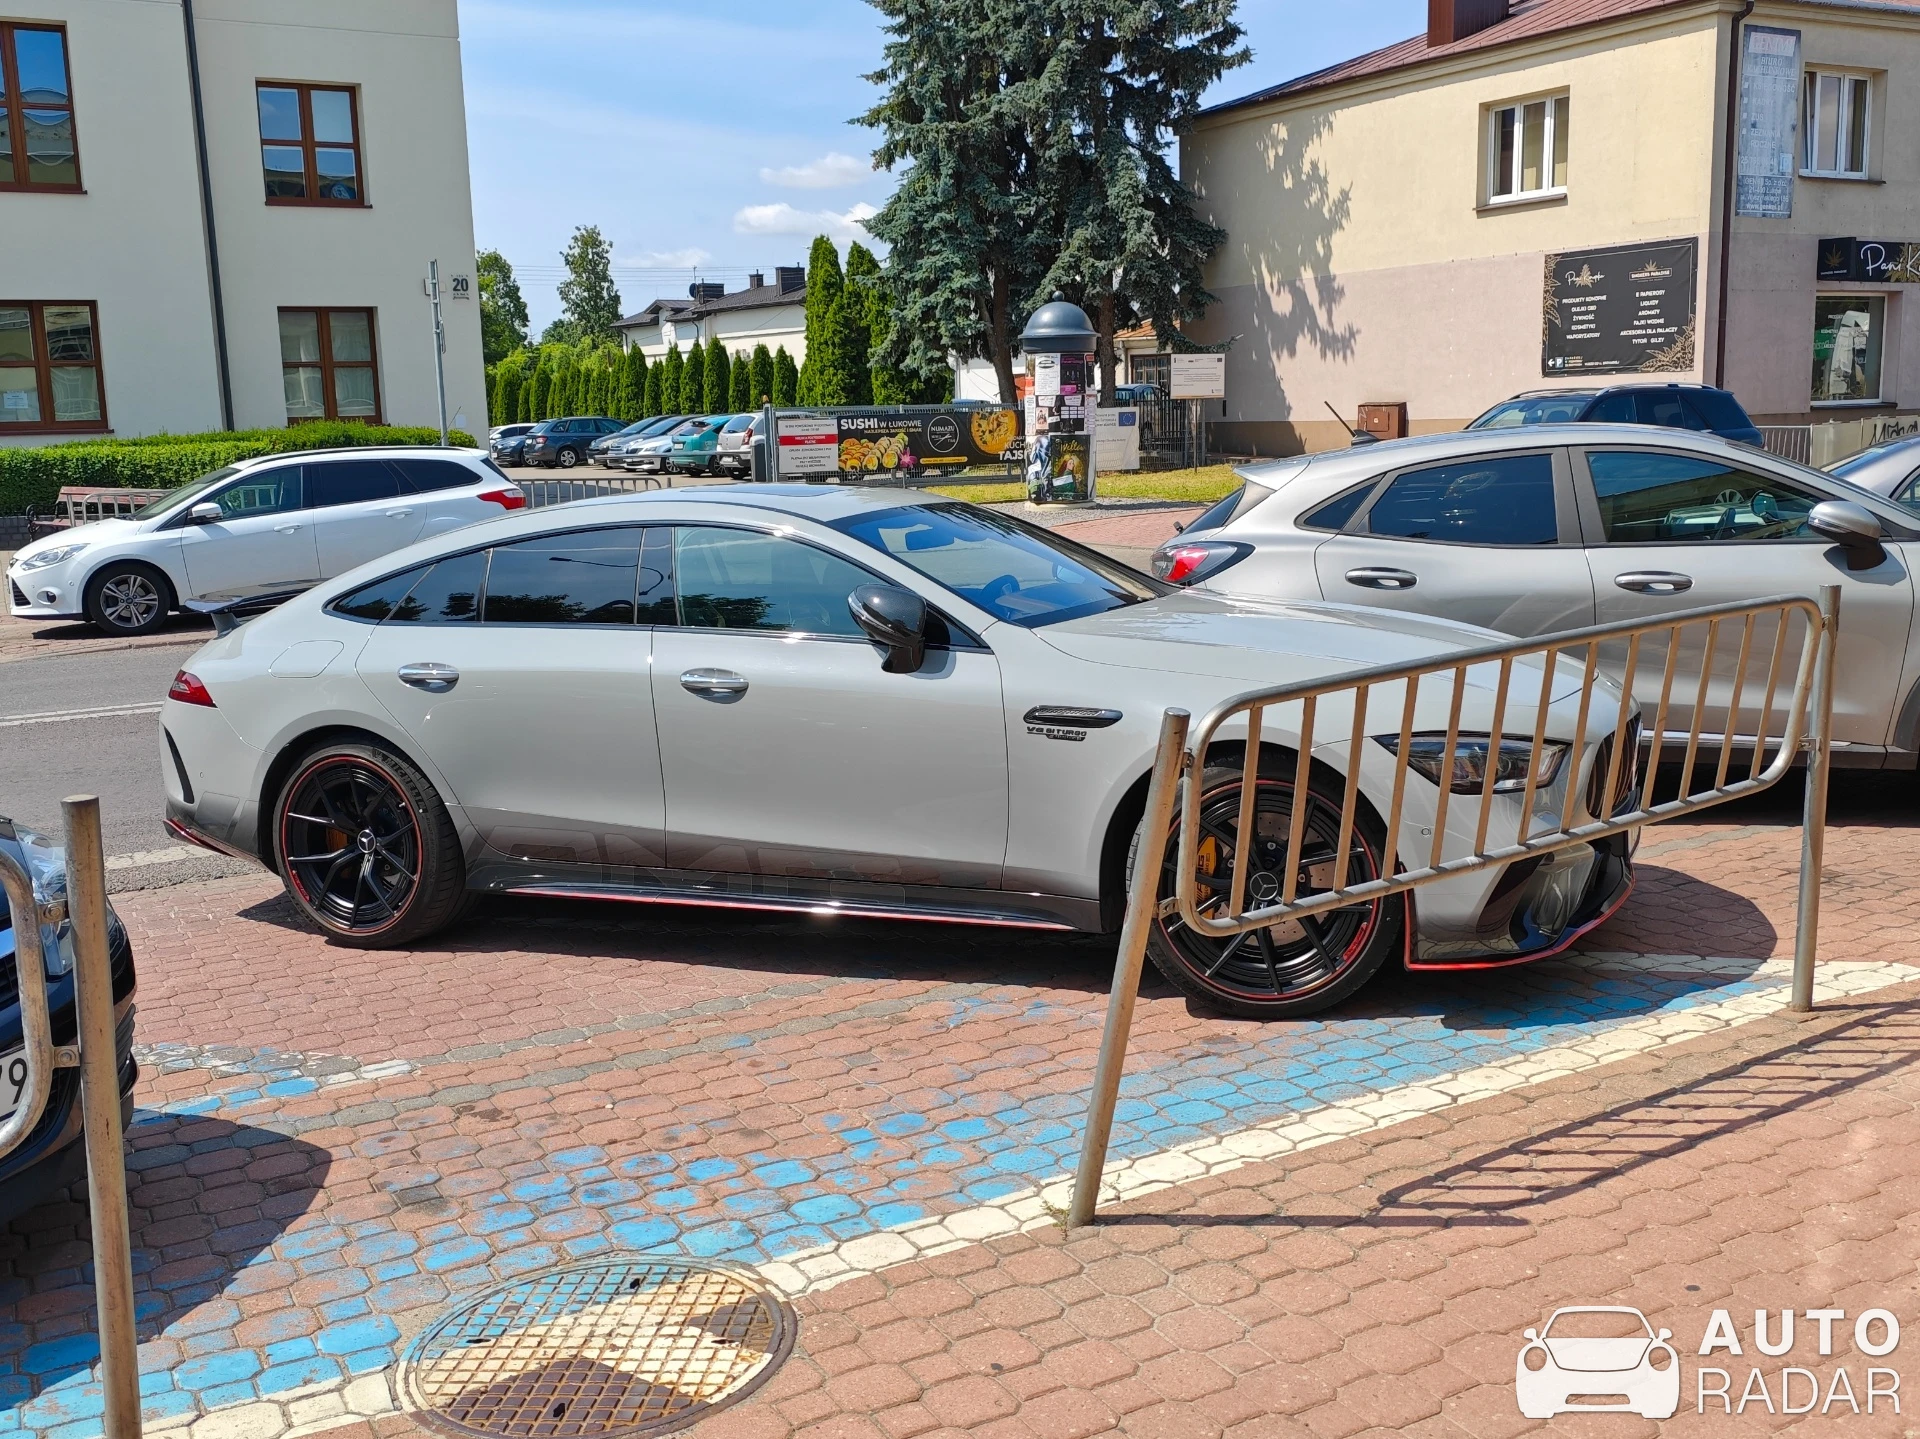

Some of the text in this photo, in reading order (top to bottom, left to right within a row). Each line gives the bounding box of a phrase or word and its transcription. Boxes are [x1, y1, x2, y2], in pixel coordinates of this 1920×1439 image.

[1761, 57, 1782, 66] BIURO
[1860, 244, 1920, 277] Pani K
[452, 278, 468, 292] 20
[840, 418, 878, 430] SUSHI
[1004, 442, 1026, 450] KUCH
[1046, 728, 1087, 736] BITURBO
[386, 757, 428, 812] MICHELIN
[0, 1058, 28, 1105] 9
